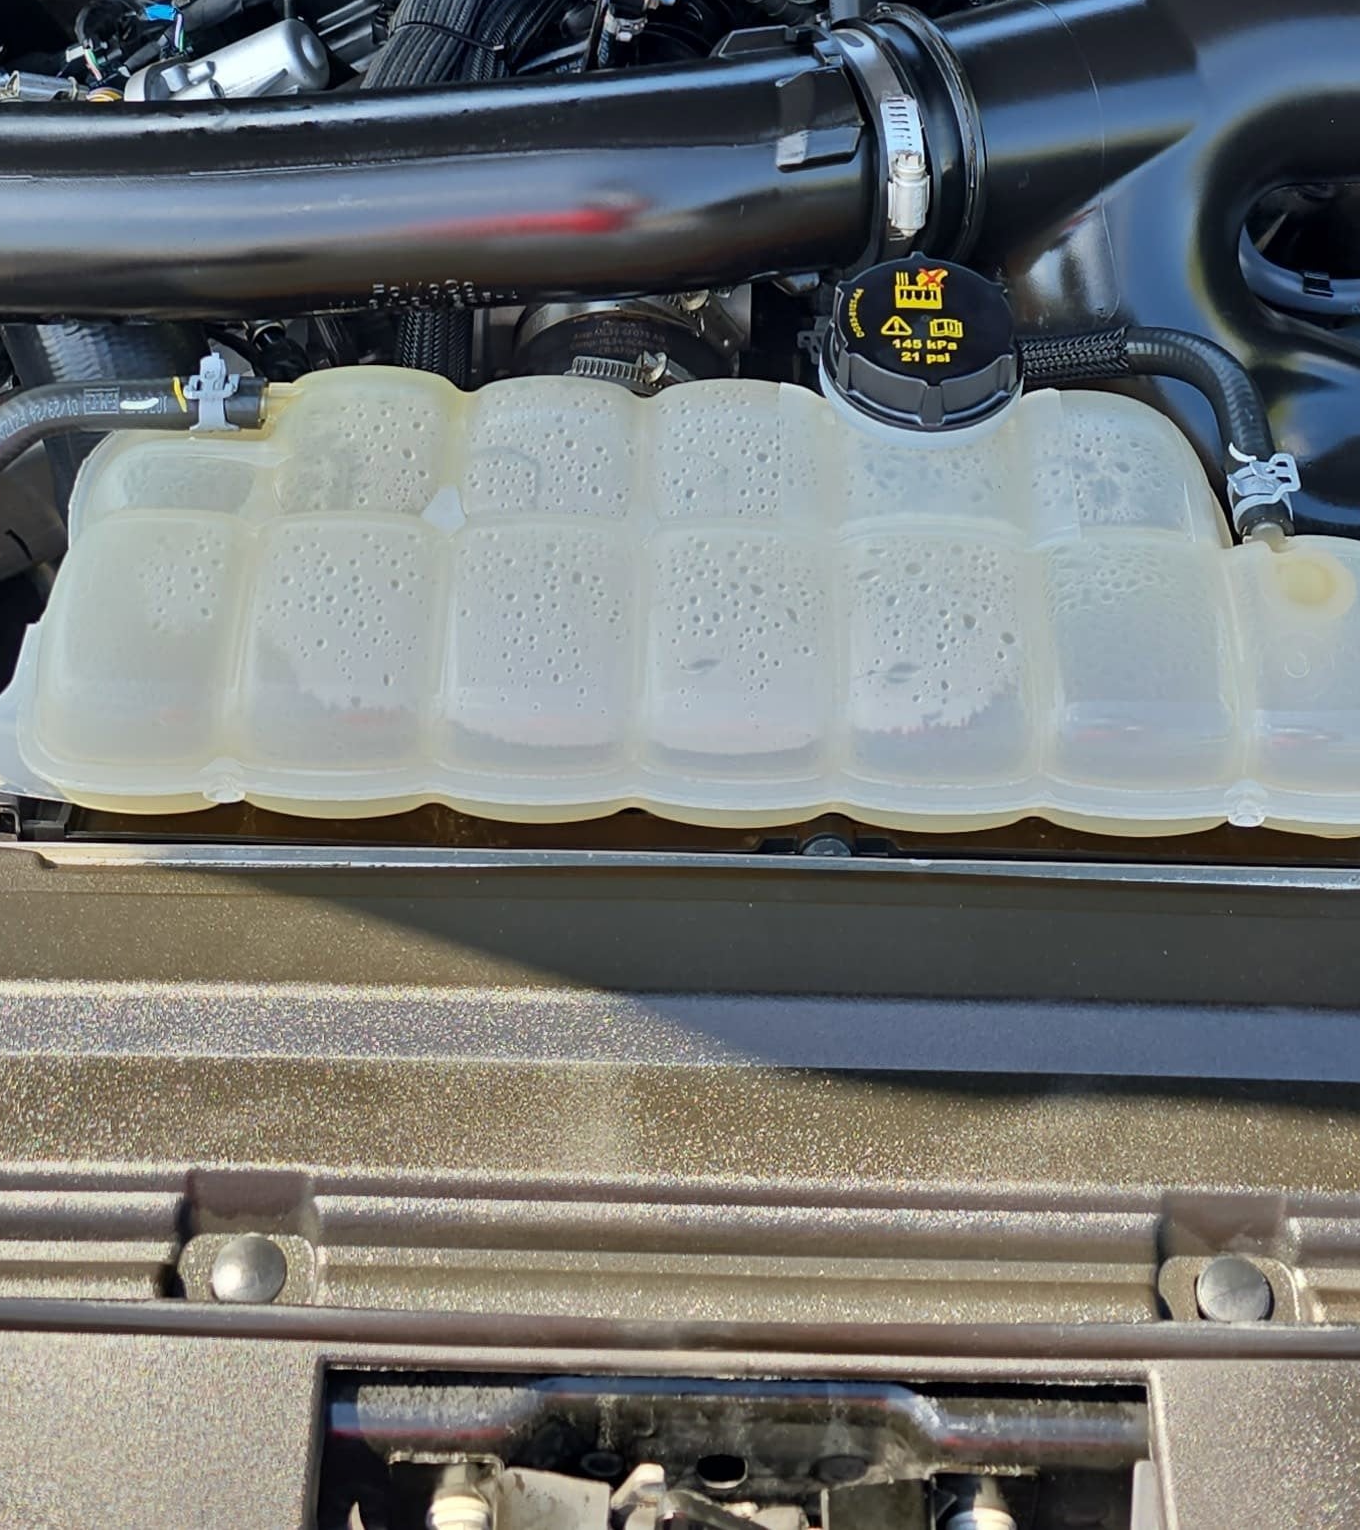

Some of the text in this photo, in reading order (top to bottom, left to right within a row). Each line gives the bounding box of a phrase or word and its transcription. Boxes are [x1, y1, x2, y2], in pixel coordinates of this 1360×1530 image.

[892, 339, 958, 351] 145 kPa
[901, 352, 951, 364] 21 psi
